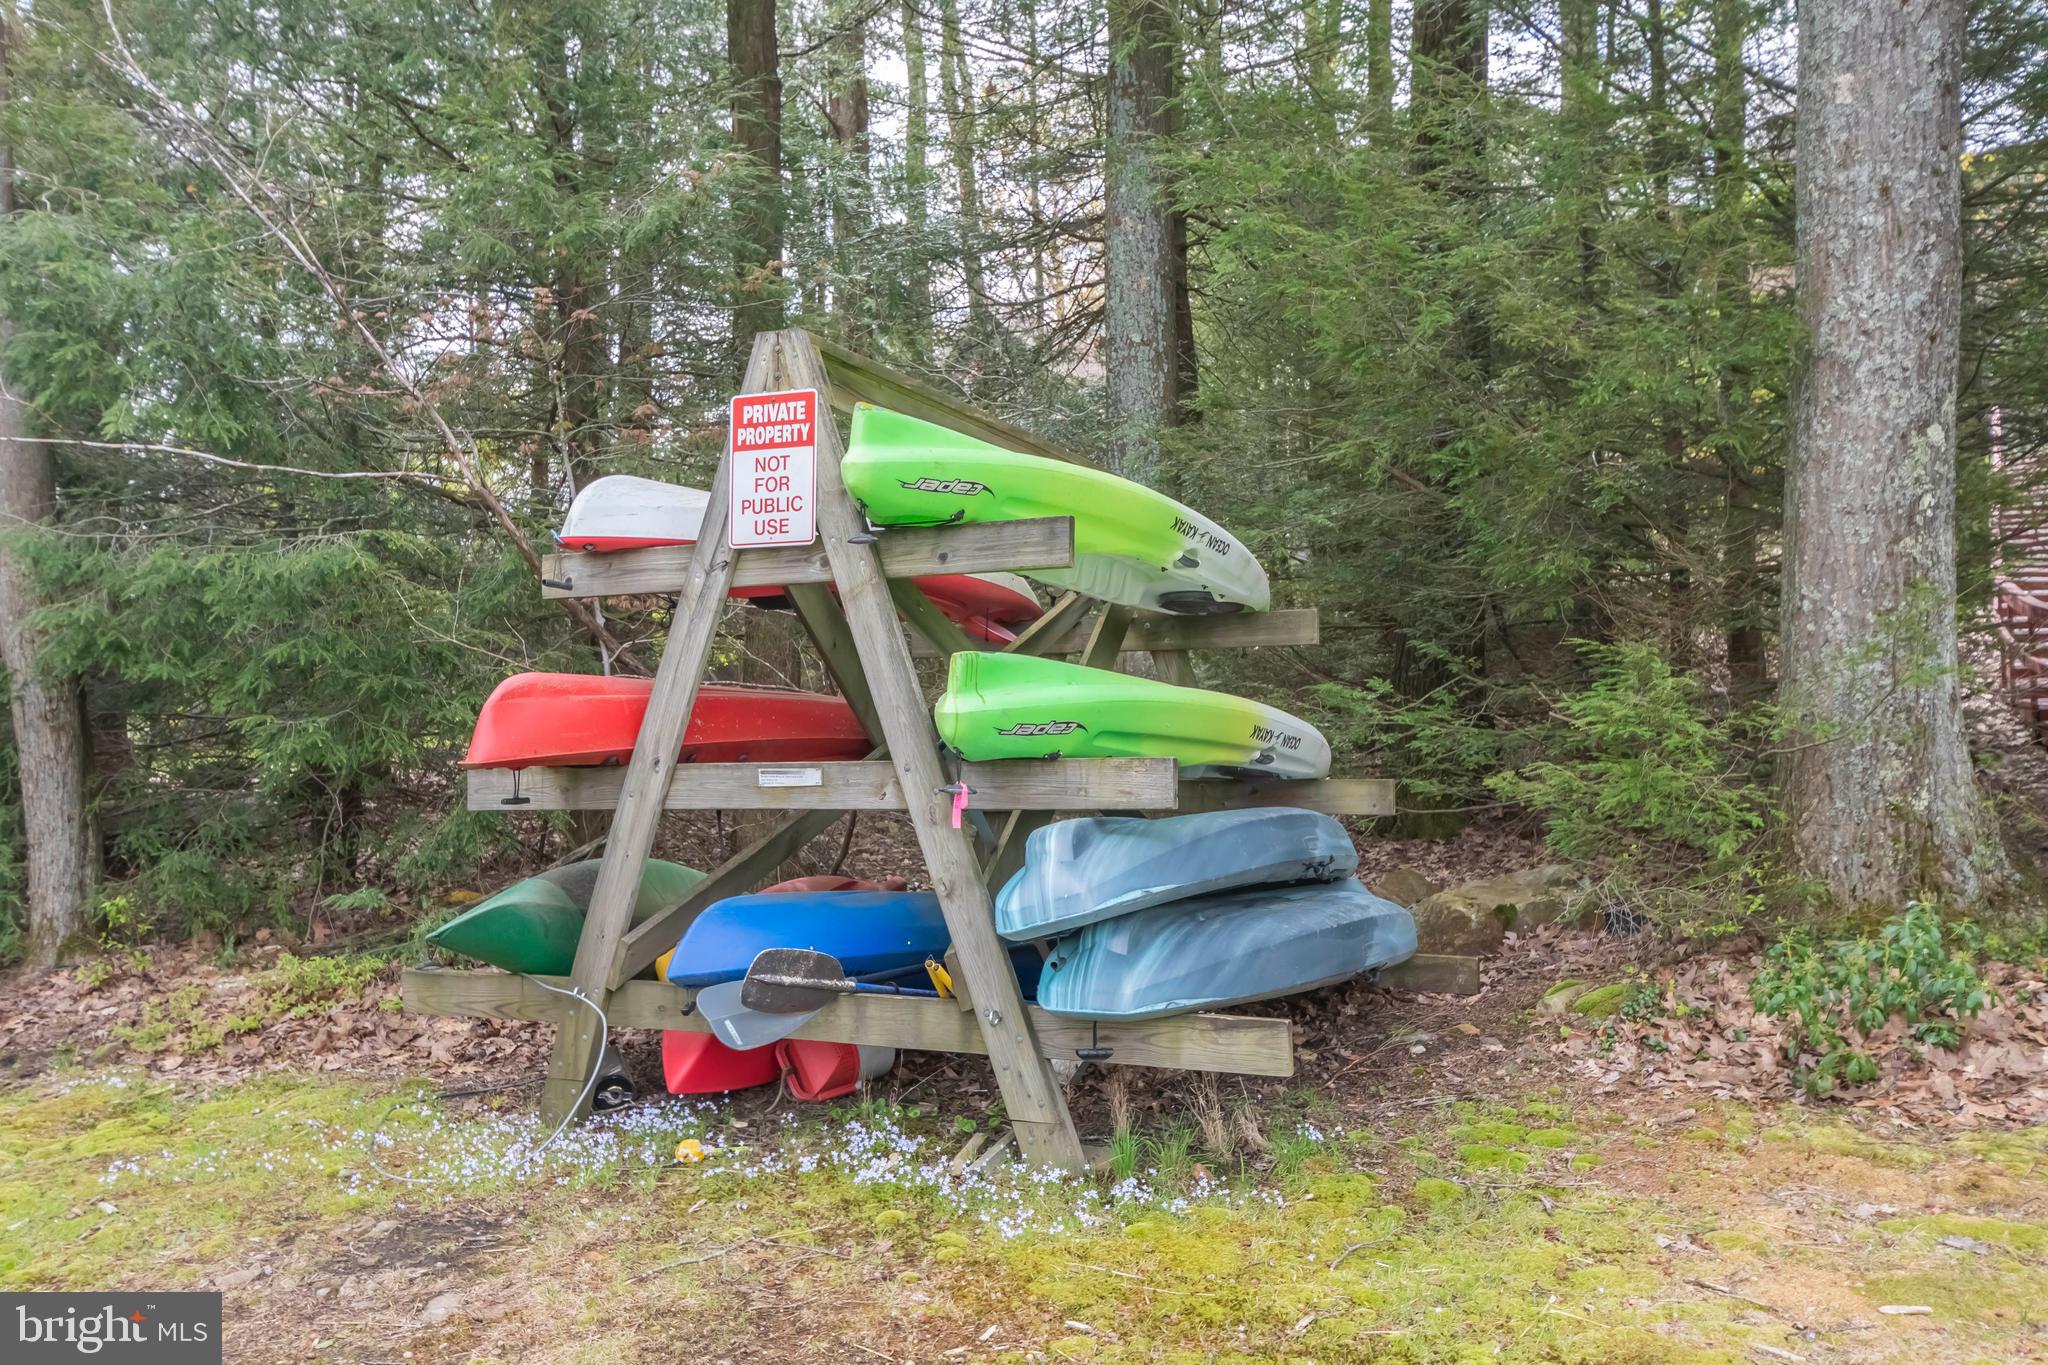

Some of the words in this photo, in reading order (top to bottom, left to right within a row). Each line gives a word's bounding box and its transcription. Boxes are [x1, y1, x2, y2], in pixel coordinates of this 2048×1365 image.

[743, 401, 806, 424] PRIVATE
[737, 423, 810, 446] PROPERTY
[754, 455, 791, 473] NOT
[754, 476, 790, 493] FOR
[741, 495, 803, 515] PUBLIC
[754, 518, 790, 535] USE
[1169, 516, 1199, 540] KAYAK
[1205, 535, 1230, 556] OCEAN
[1249, 724, 1275, 743] KAYAK
[1280, 734, 1301, 750] OCEAN
